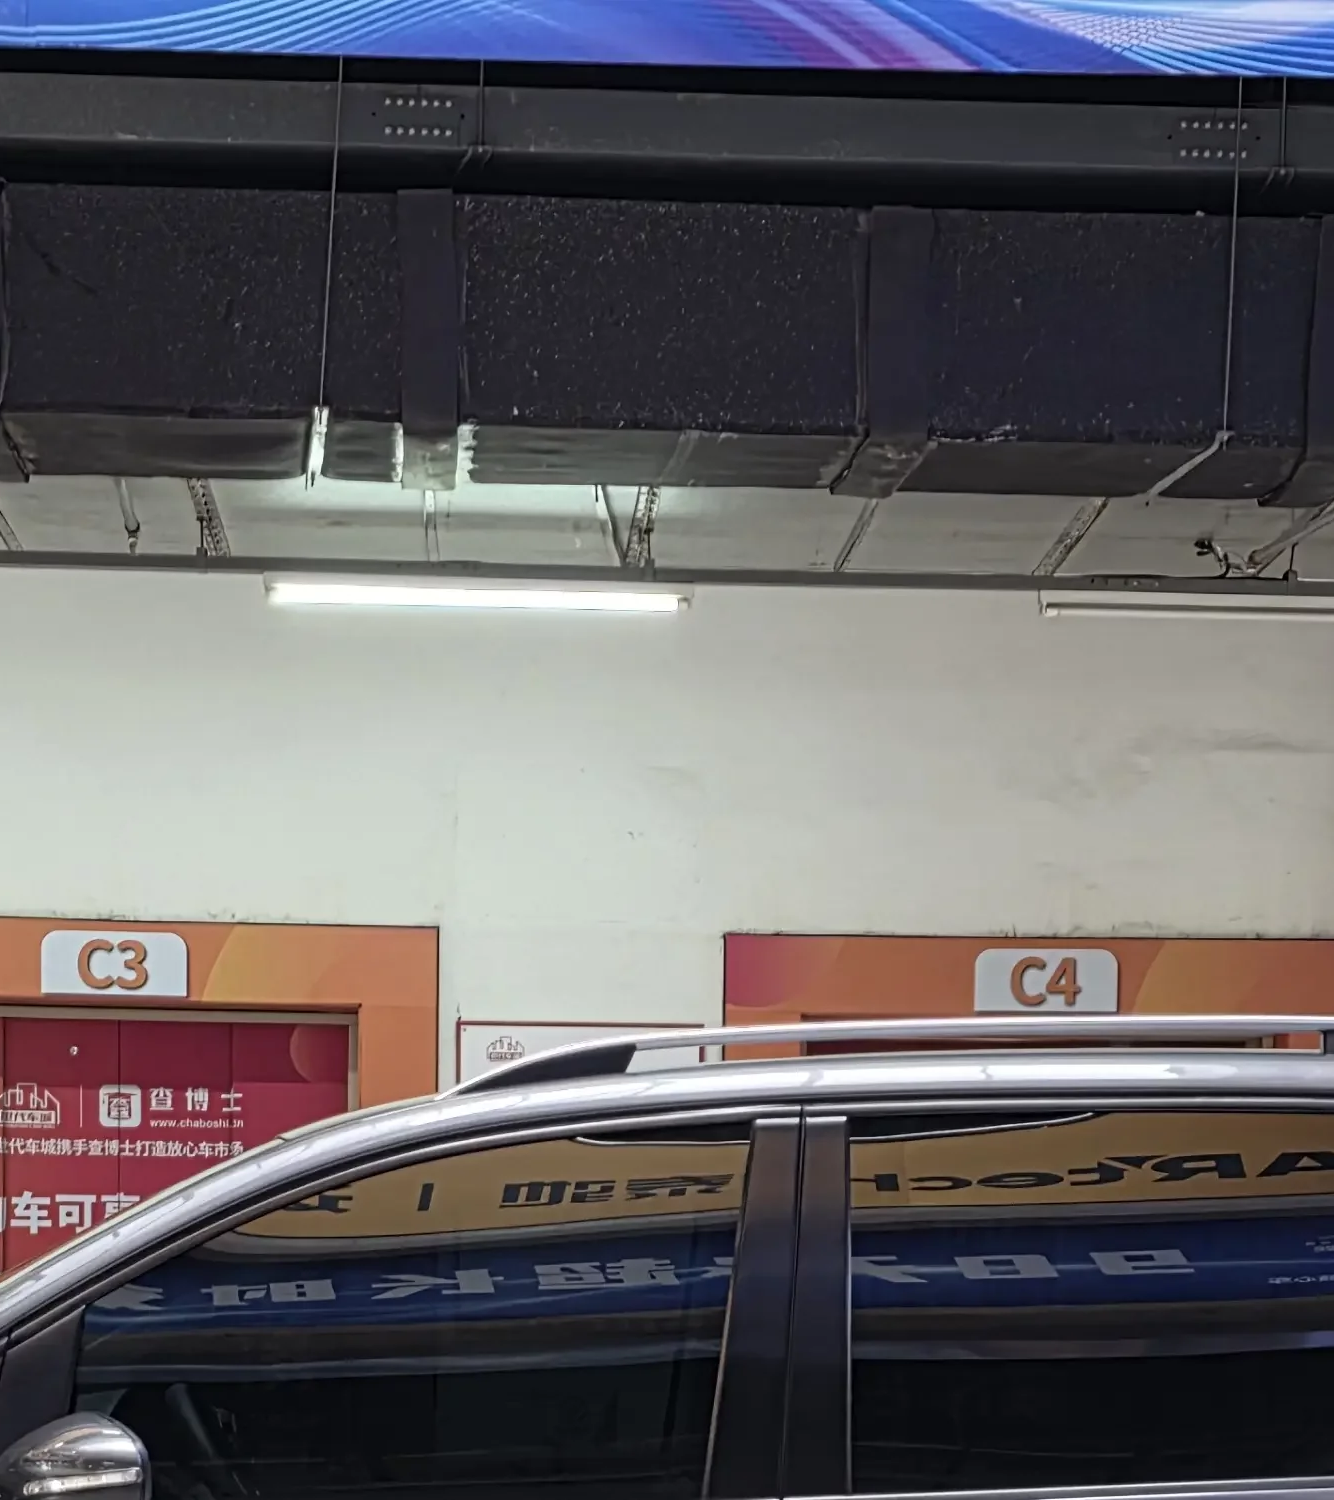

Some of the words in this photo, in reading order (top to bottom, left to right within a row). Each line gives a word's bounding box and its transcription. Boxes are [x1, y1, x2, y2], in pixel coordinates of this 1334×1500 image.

[77, 938, 148, 990] C3
[1010, 955, 1081, 1007] C4
[149, 1086, 244, 1112] 查博士
